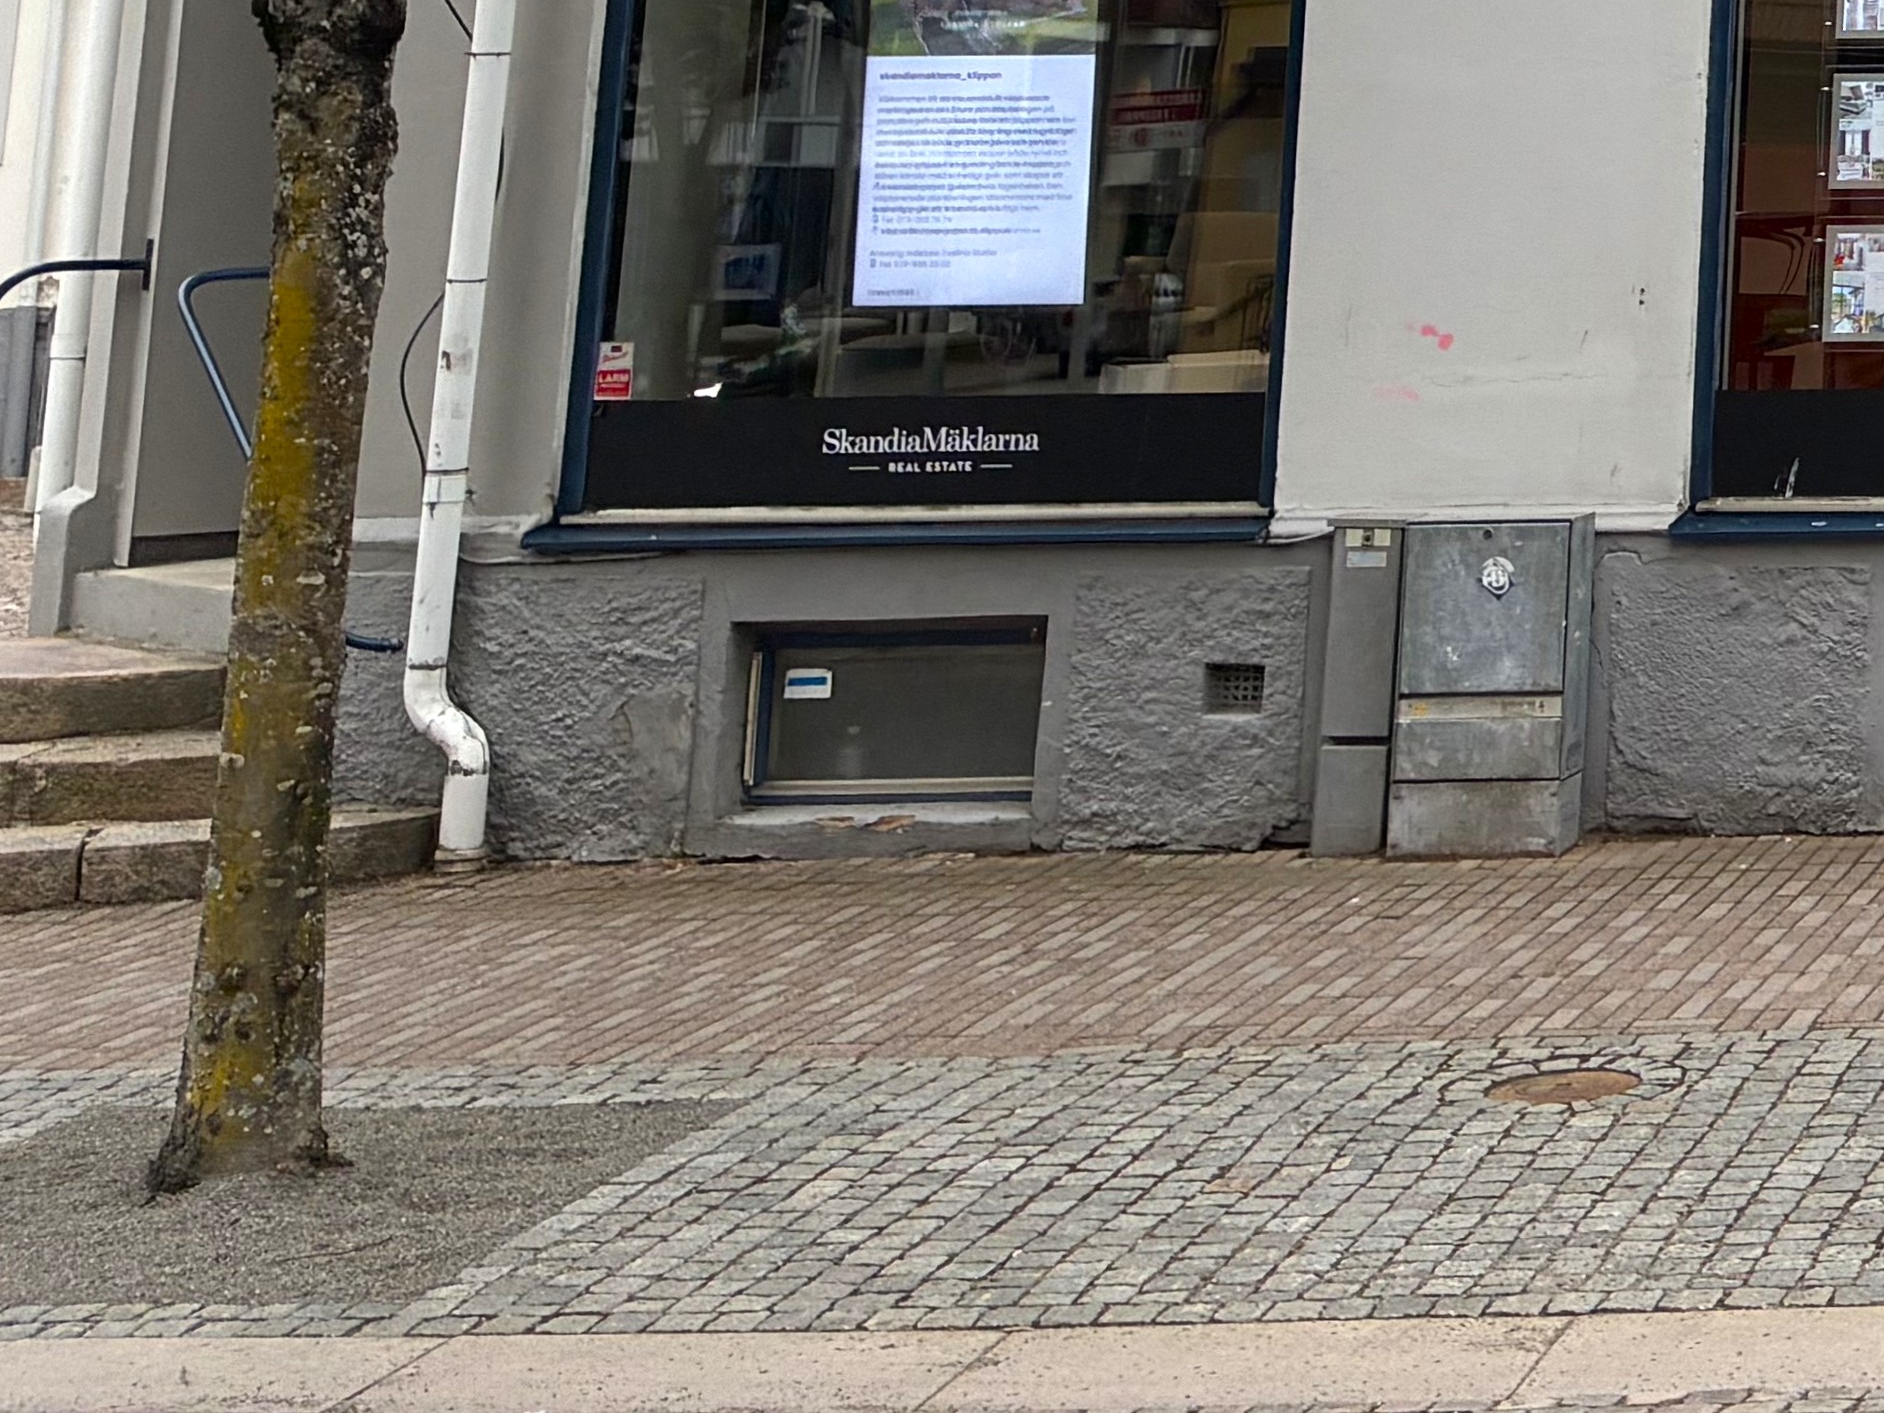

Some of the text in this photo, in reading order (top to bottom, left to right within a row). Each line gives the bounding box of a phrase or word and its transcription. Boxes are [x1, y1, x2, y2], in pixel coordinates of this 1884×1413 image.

[822, 426, 1040, 454] SkandiaMäklarna
[888, 460, 973, 473] REAL ESTATE
